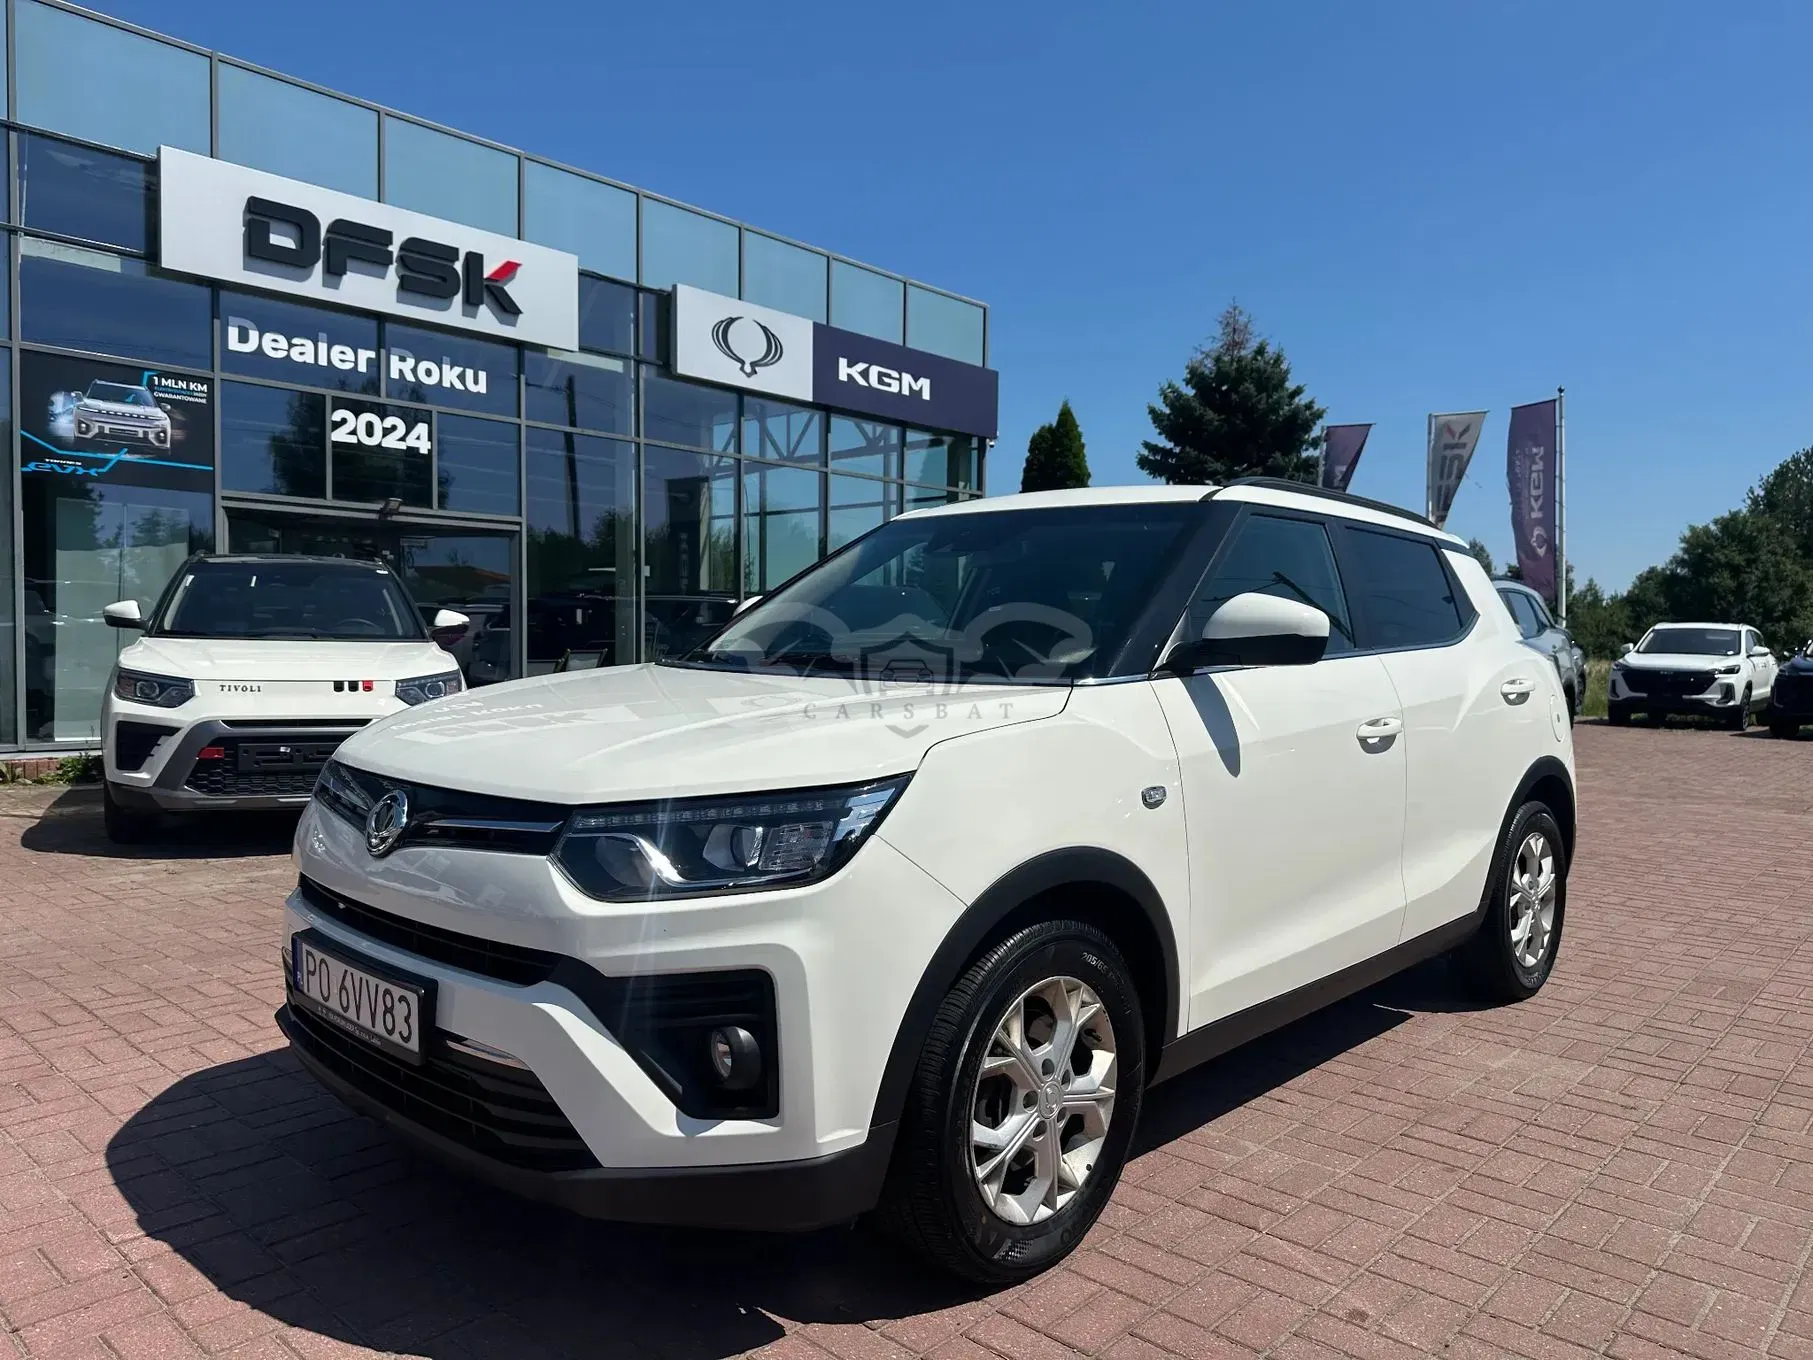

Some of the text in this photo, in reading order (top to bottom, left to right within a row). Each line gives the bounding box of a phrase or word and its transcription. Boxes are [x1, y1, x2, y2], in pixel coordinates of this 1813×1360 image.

[246, 195, 523, 315] DFSK
[227, 316, 488, 394] Dealer Roku
[153, 376, 159, 386] 1
[161, 377, 187, 390] MLN
[189, 381, 208, 393] KM
[838, 356, 931, 401] KGM
[331, 408, 431, 454] 2024
[219, 684, 261, 693] TIVOLI
[338, 969, 412, 1044] 6VV83
